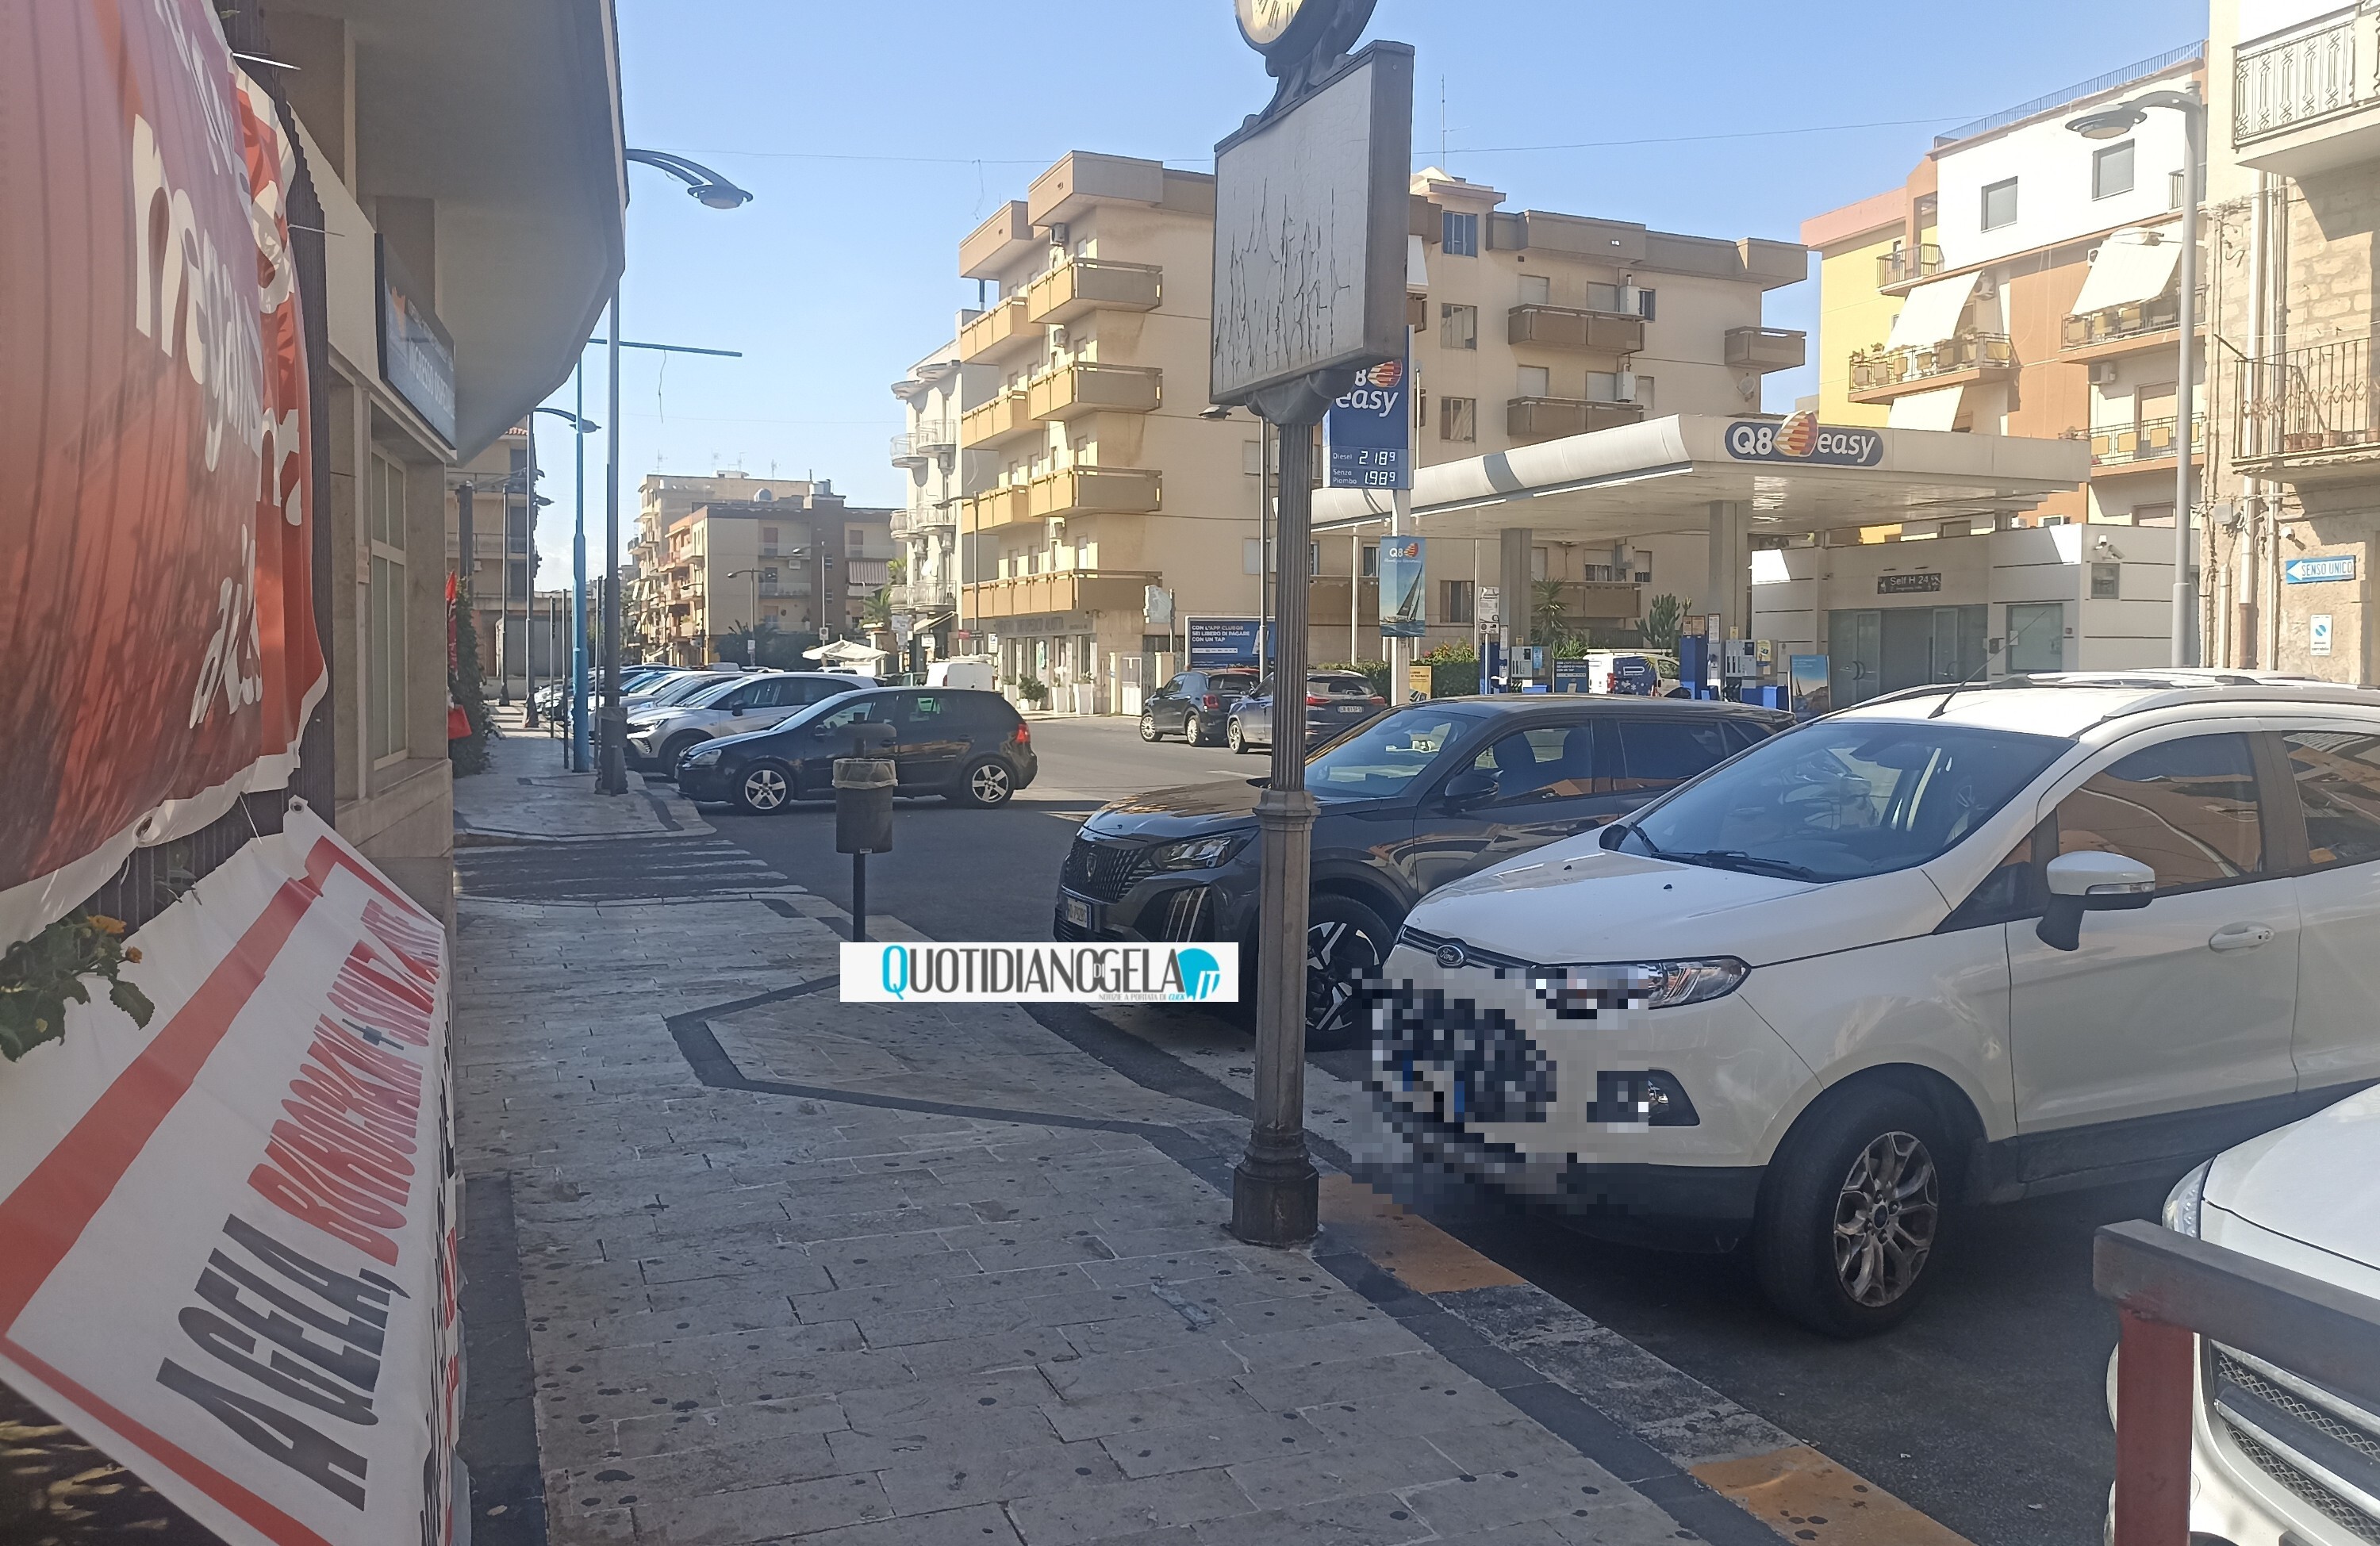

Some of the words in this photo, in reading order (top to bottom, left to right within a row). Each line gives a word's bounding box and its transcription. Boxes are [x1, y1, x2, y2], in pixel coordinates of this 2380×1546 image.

[1334, 388, 1399, 418] easy
[1732, 426, 1774, 456] Q8
[1816, 432, 1876, 463] easy
[1389, 547, 1403, 558] Q8
[1890, 576, 1907, 585] Self
[1909, 576, 1916, 585] H
[1917, 575, 1929, 585] 24
[2301, 563, 2327, 577] SENSO
[2328, 561, 2353, 574] UNICO
[178, 1214, 411, 1426] GELA,
[155, 1357, 368, 1511] A
